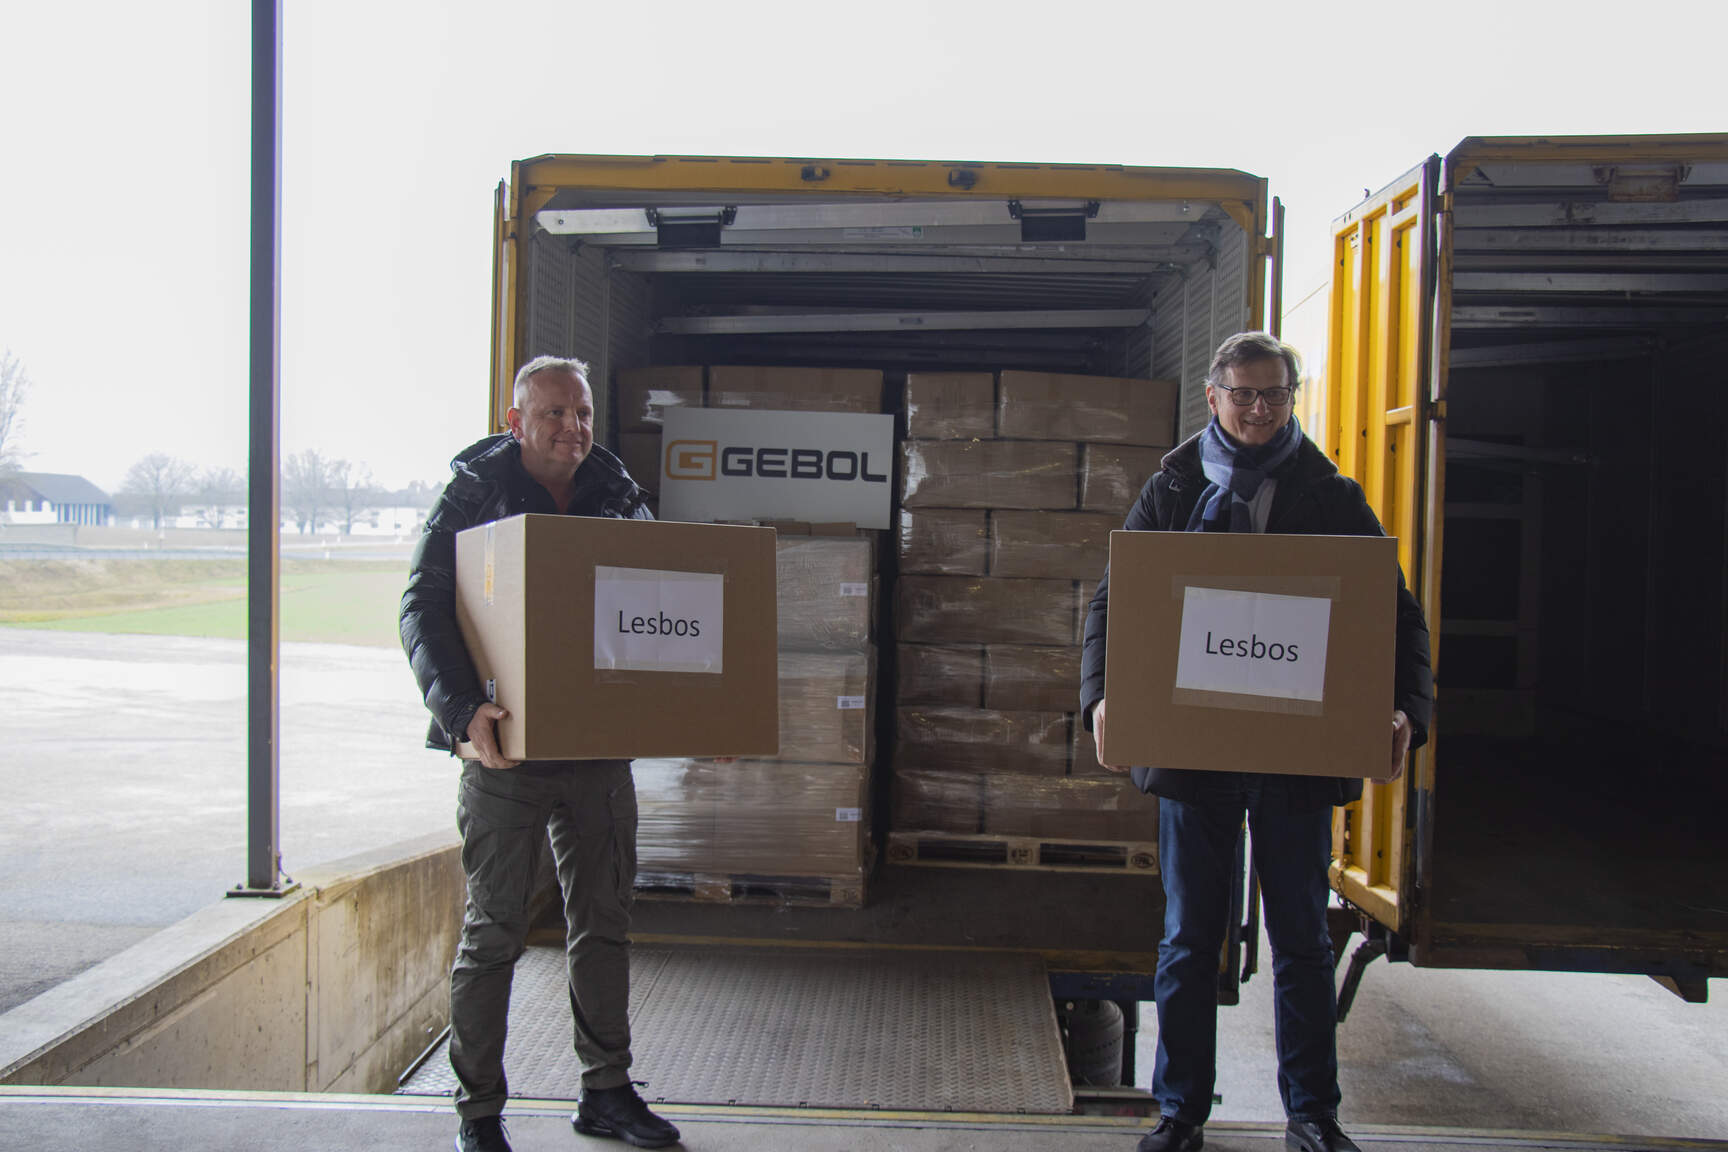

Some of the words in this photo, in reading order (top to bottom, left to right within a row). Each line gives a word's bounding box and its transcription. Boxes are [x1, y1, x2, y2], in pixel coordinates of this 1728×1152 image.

[721, 447, 888, 483] GEBOL
[619, 609, 701, 637] Lesbos
[1206, 631, 1299, 662] Lesbos
